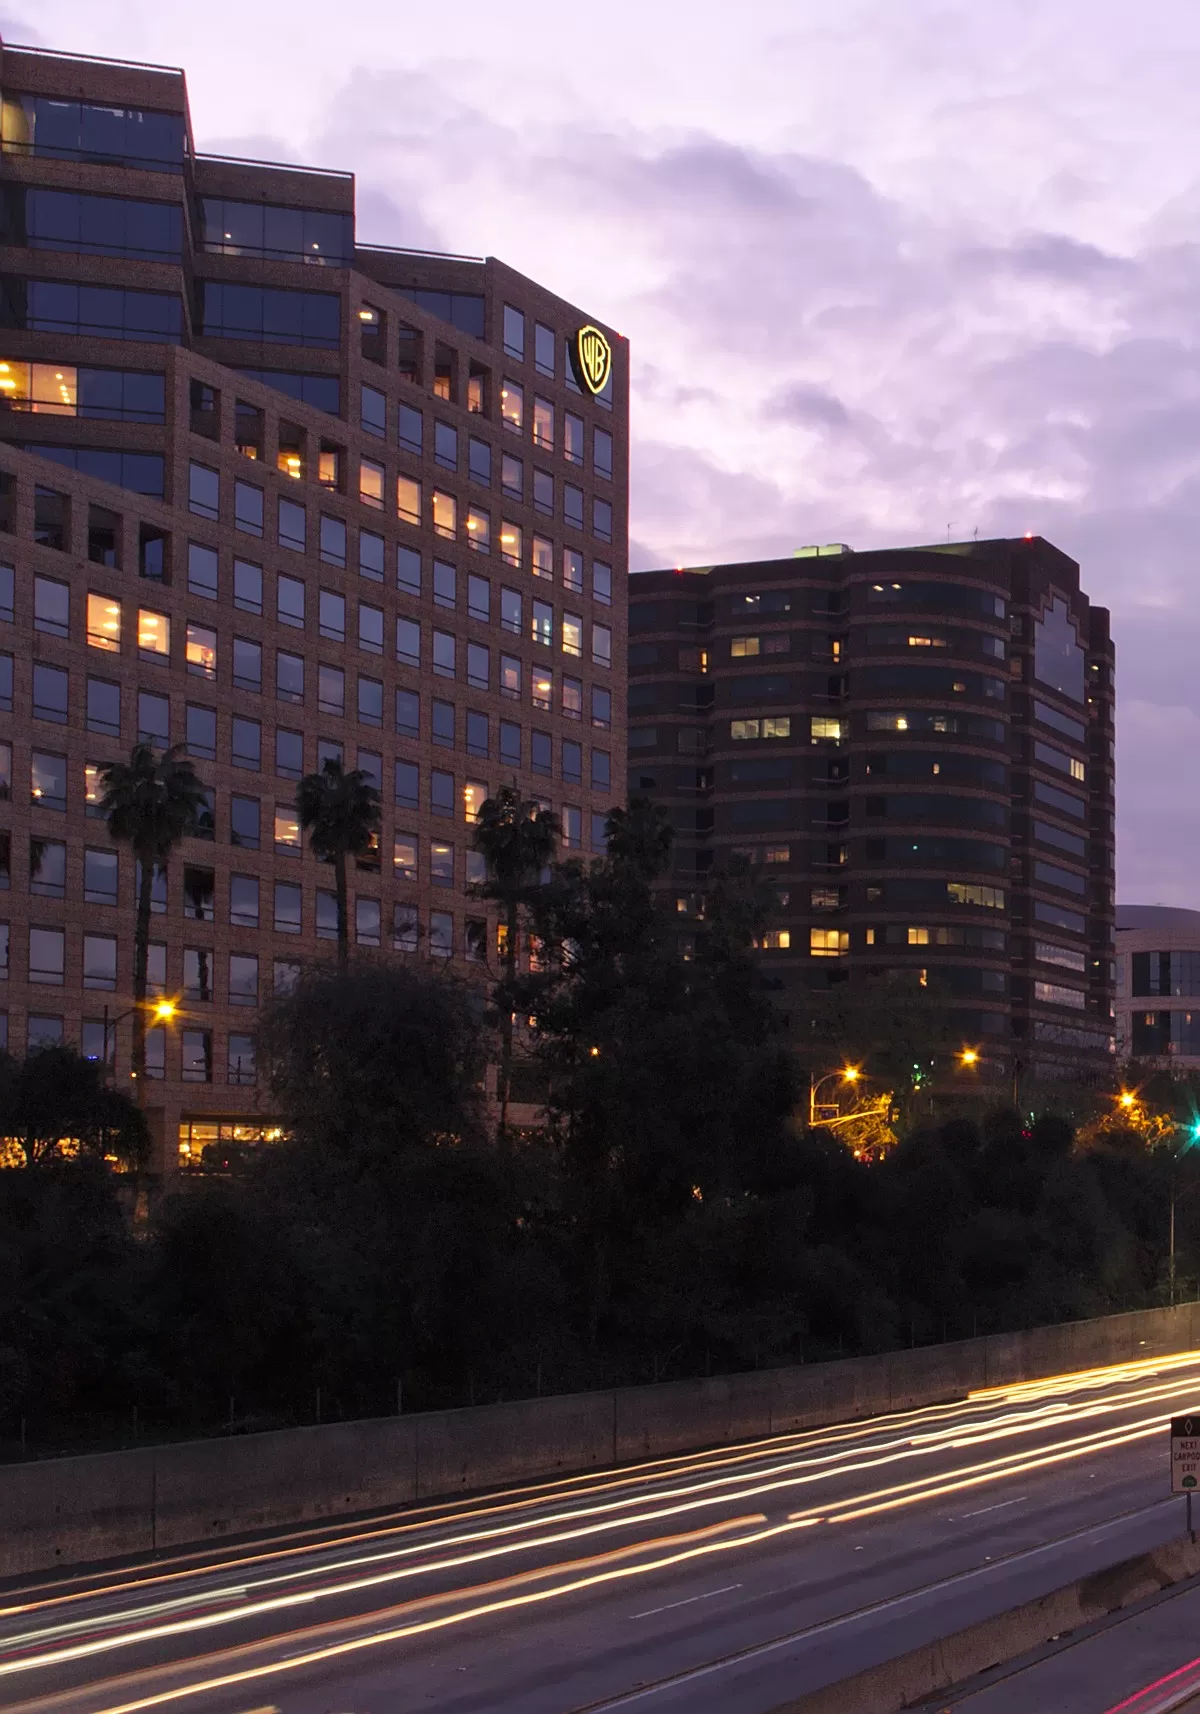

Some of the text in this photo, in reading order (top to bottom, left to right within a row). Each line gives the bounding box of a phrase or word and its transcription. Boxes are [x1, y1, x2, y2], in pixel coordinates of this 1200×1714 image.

[583, 335, 606, 382] WB
[1180, 1441, 1197, 1450] NEXT
[1182, 1463, 1196, 1472] EXIT
